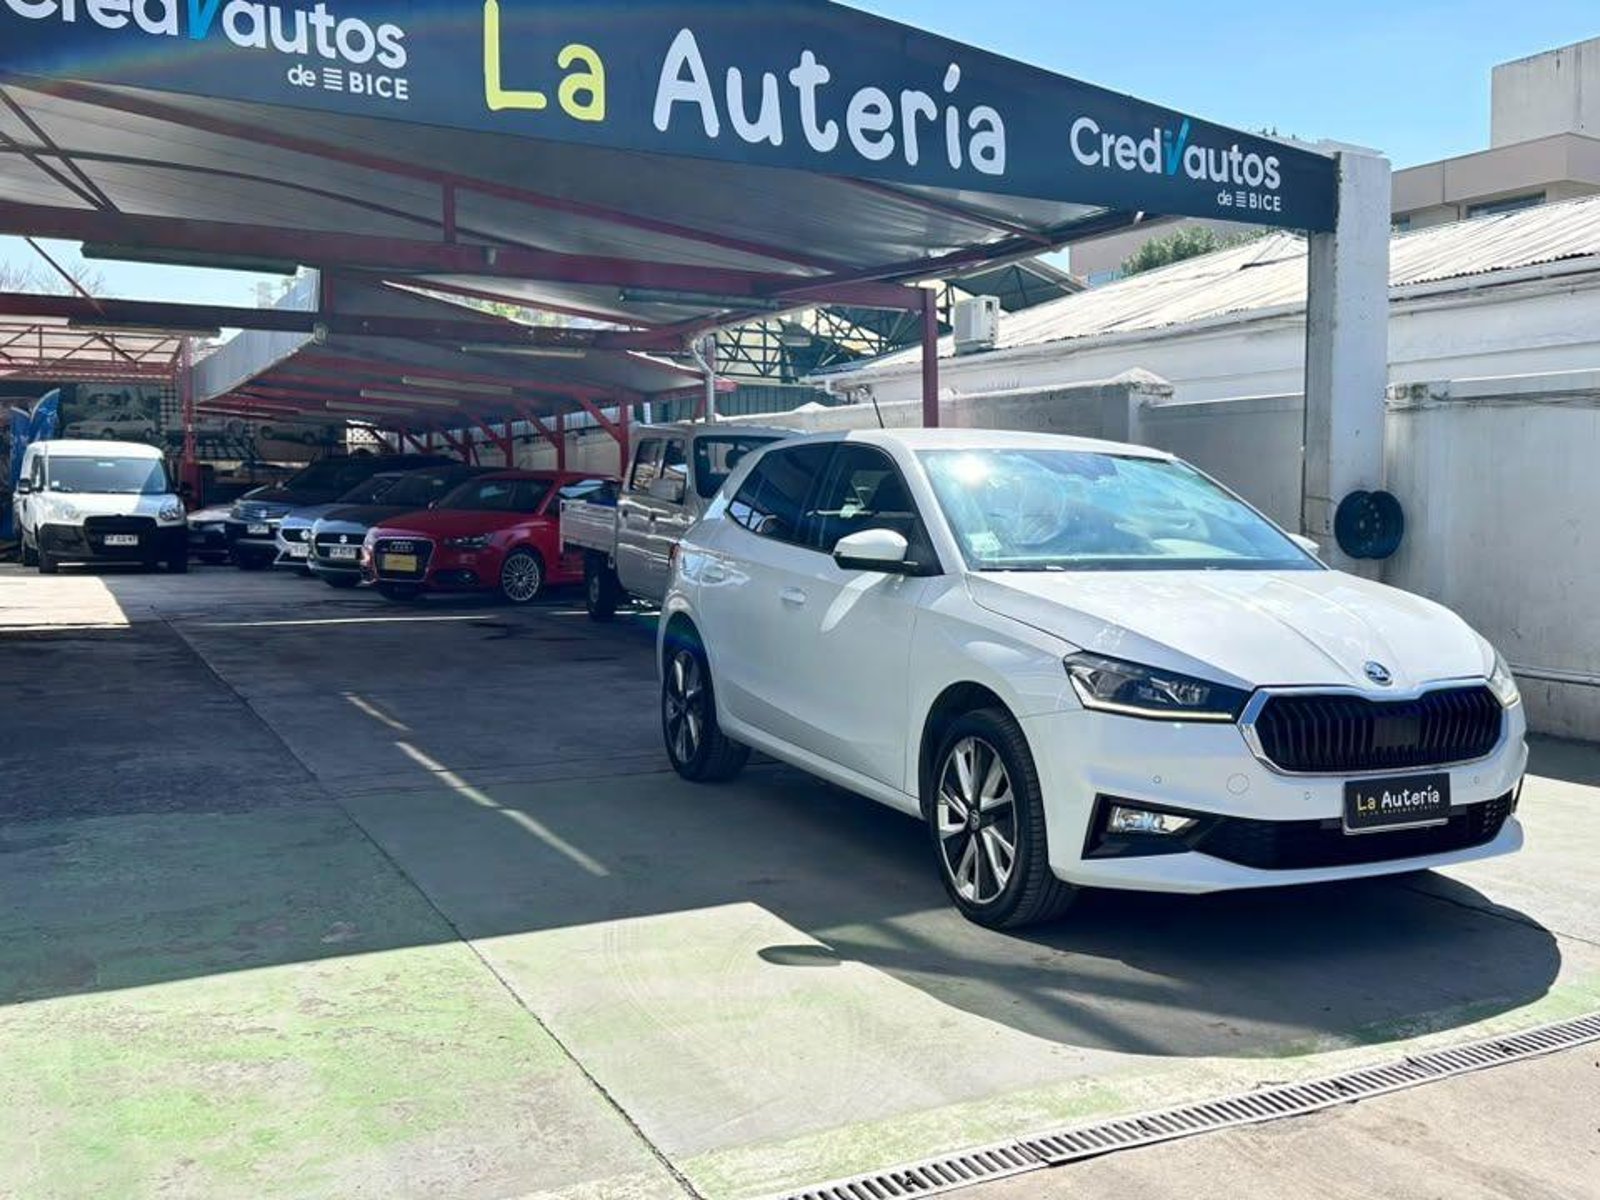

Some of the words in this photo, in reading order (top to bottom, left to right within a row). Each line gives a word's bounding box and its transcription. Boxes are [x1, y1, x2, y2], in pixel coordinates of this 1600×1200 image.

[287, 64, 316, 87] de
[349, 71, 409, 100] BICE
[484, 0, 606, 121] La
[653, 27, 1006, 175] Autería
[1217, 189, 1232, 206] de
[1249, 192, 1281, 212] BICE
[1357, 792, 1376, 811] La
[1381, 784, 1440, 809] Autería
